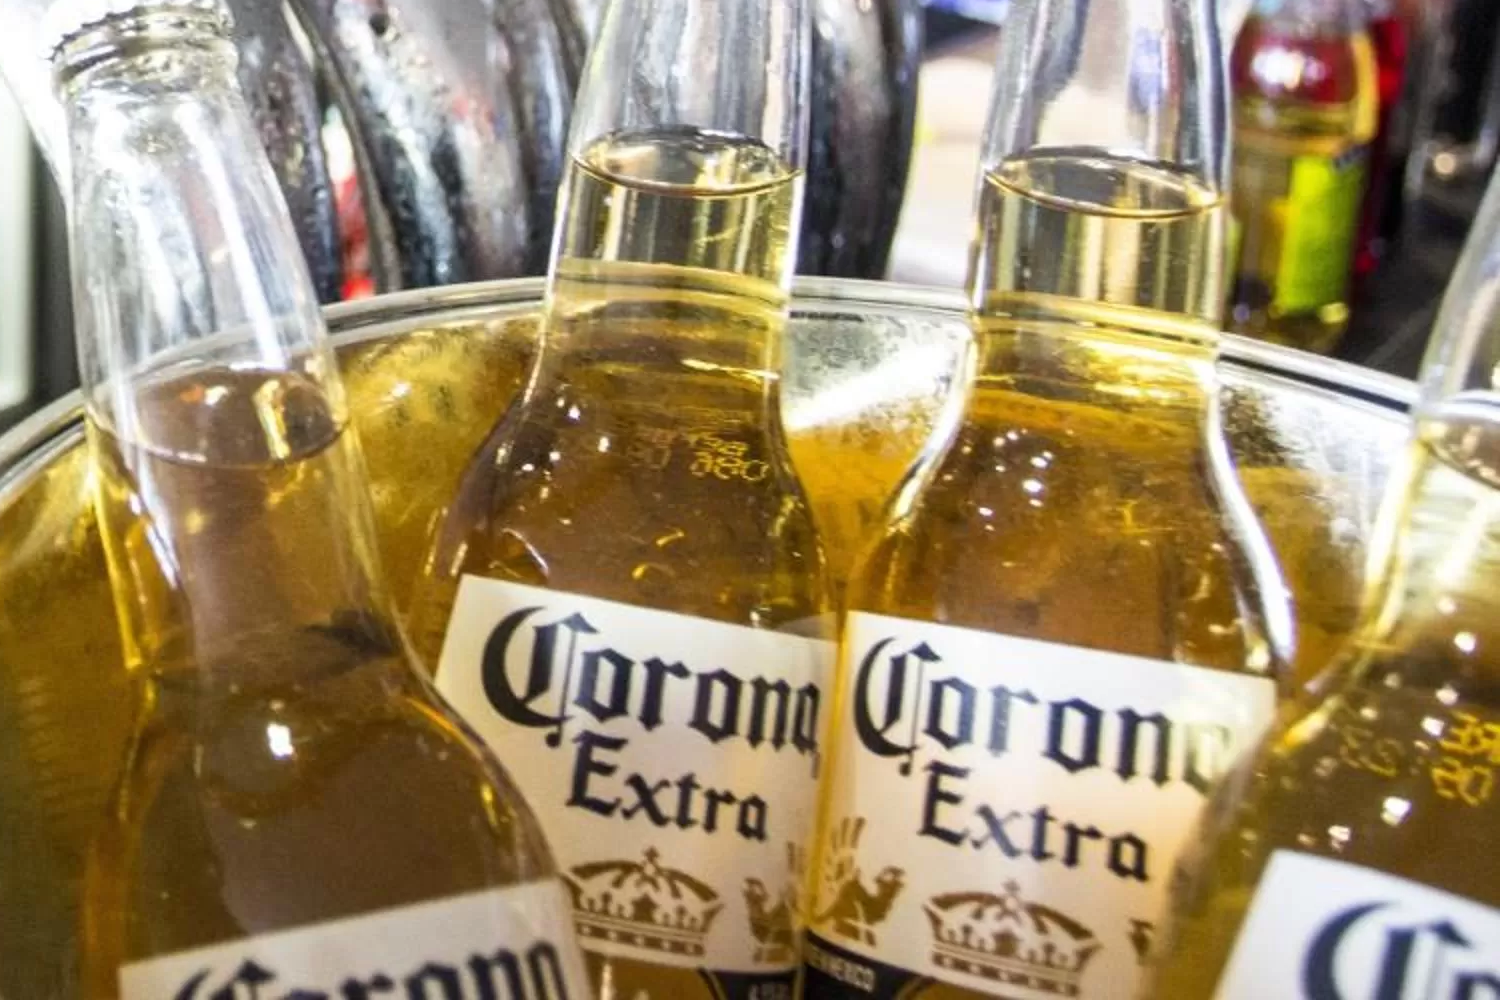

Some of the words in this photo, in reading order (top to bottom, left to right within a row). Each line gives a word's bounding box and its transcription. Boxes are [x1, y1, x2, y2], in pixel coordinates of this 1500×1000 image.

[480, 606, 821, 756] Corona
[854, 635, 1230, 799] Corona
[565, 729, 770, 843] Extra
[918, 761, 1150, 884] Extra
[173, 940, 568, 1000] ona
